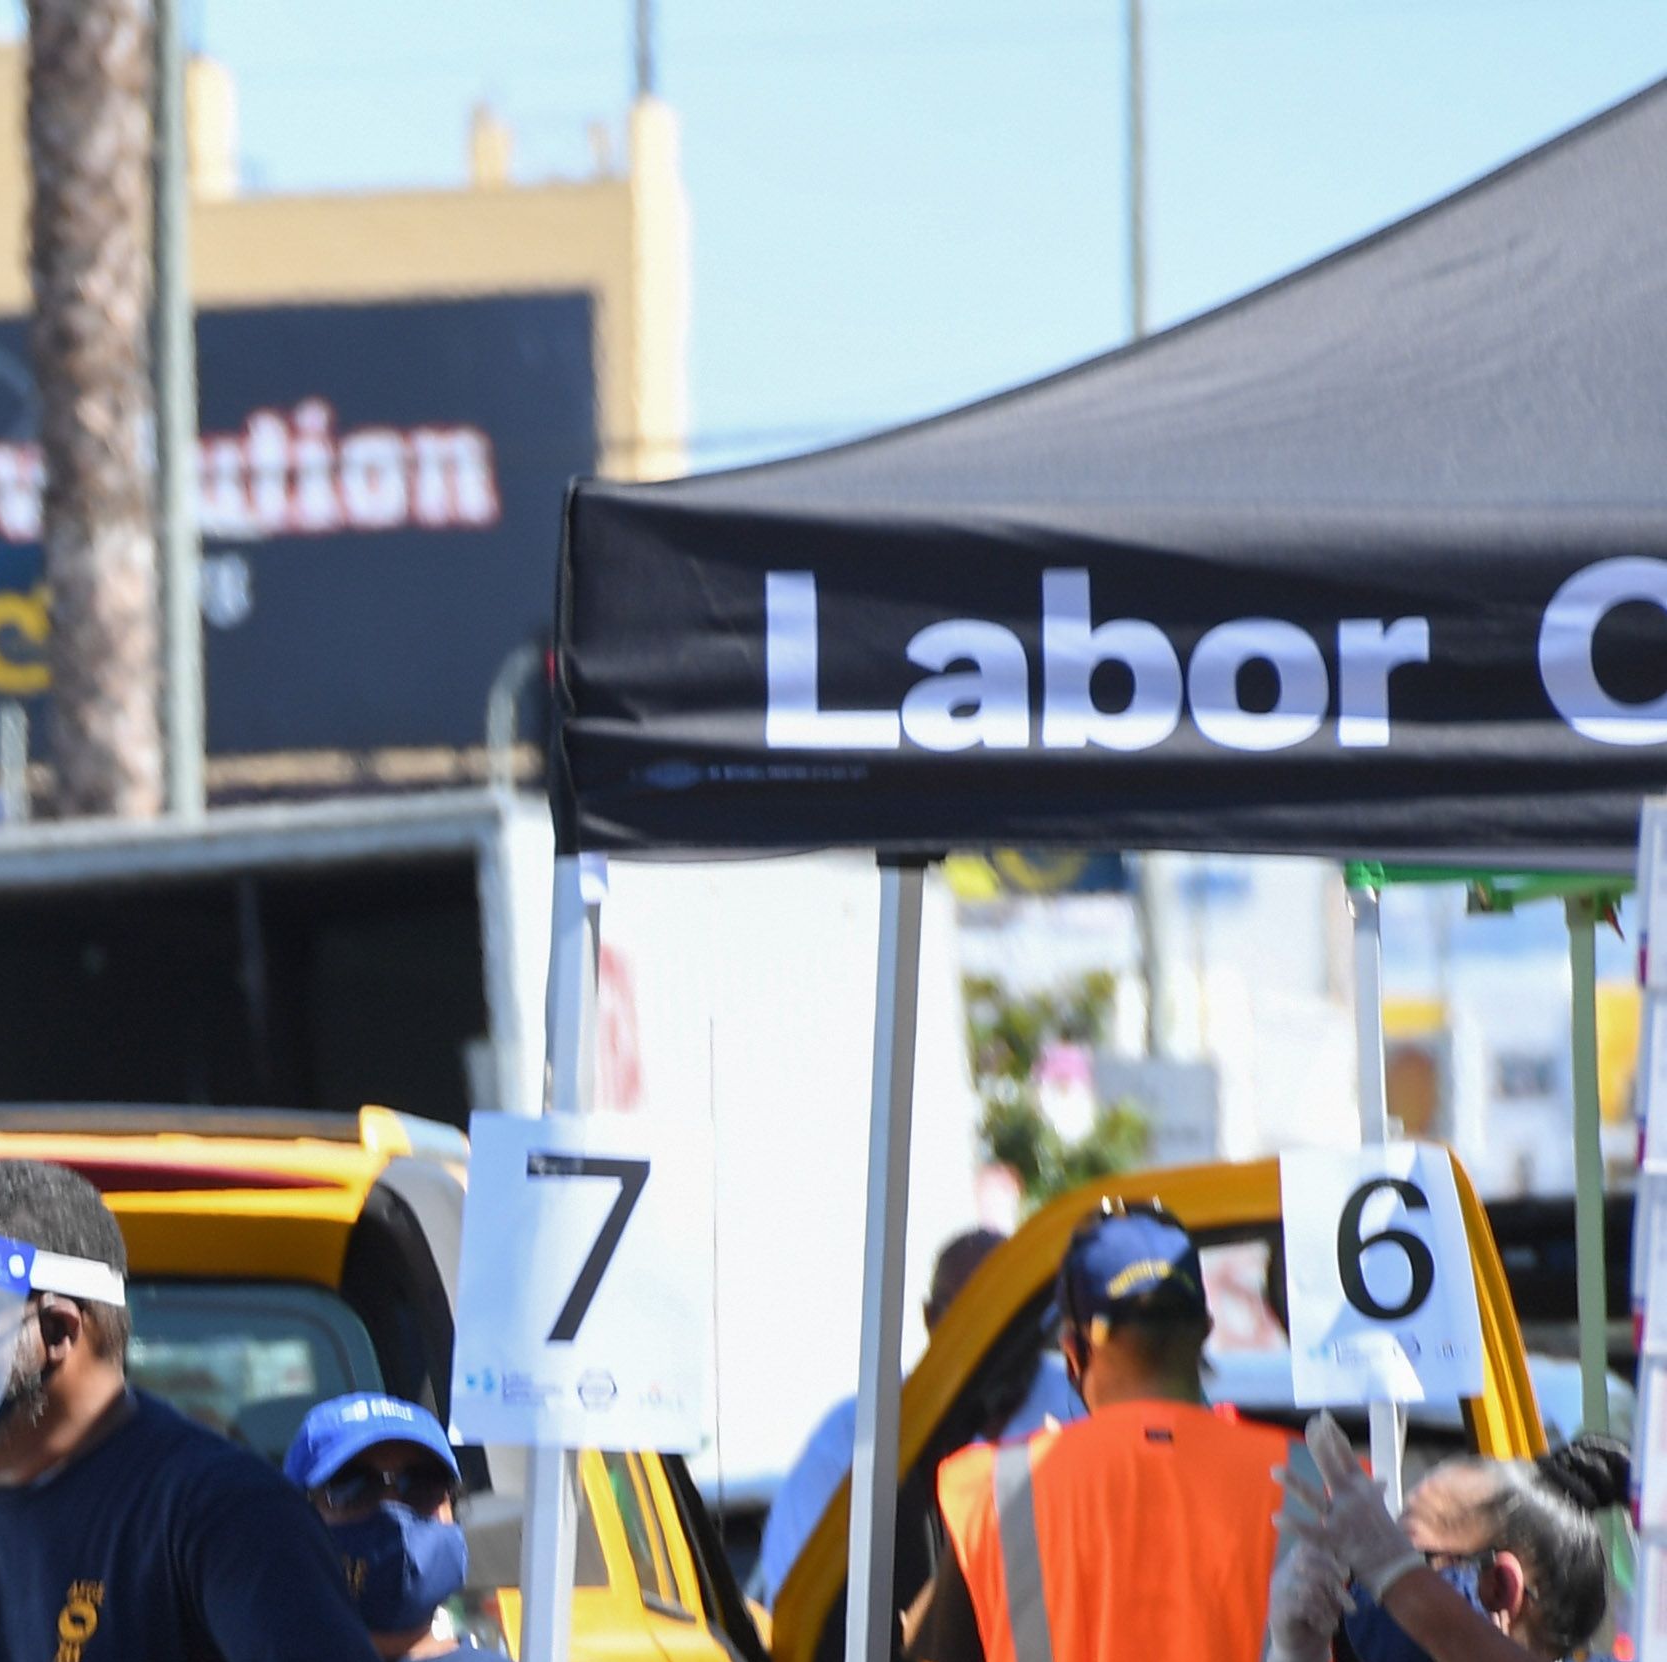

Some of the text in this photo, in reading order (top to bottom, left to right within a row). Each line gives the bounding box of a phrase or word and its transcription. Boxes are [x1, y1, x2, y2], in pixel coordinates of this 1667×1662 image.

[764, 566, 1430, 753] Labor
[526, 1150, 651, 1342] 7
[1336, 1178, 1435, 1321] 6
